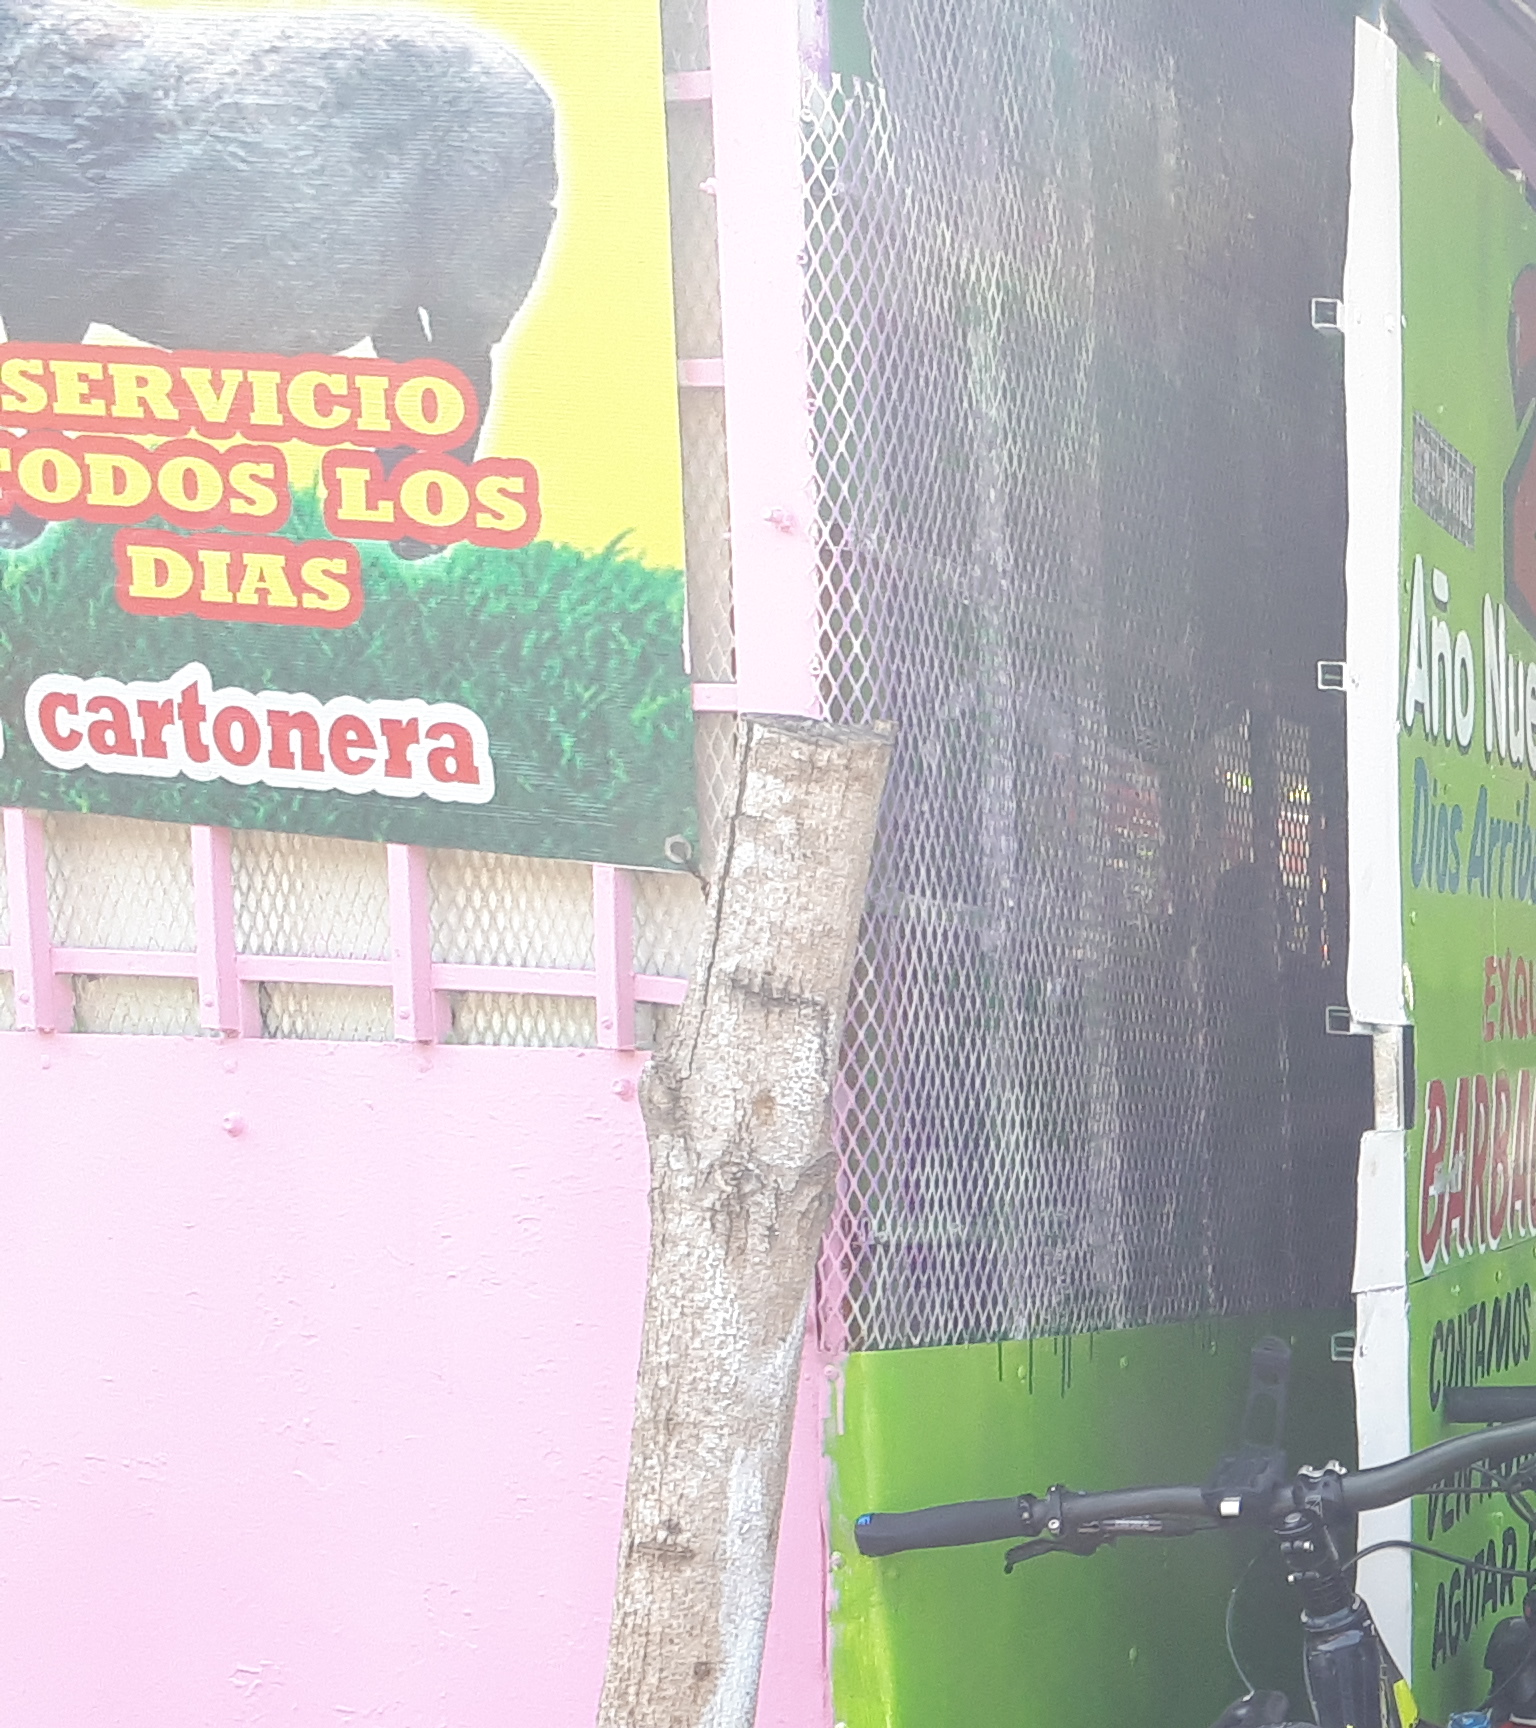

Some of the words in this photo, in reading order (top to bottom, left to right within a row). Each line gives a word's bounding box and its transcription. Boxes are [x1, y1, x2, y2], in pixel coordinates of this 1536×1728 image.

[1, 358, 465, 435] SERVICIO
[0, 448, 279, 516] ODOS
[336, 468, 528, 531] LOS
[126, 545, 351, 611] DIAS
[1402, 553, 1474, 748] Año
[38, 680, 481, 786] cartonera
[1411, 757, 1463, 895] Dios
[1428, 1282, 1532, 1413] CONTAMOS
[1431, 1526, 1517, 1671] AGOTAR
